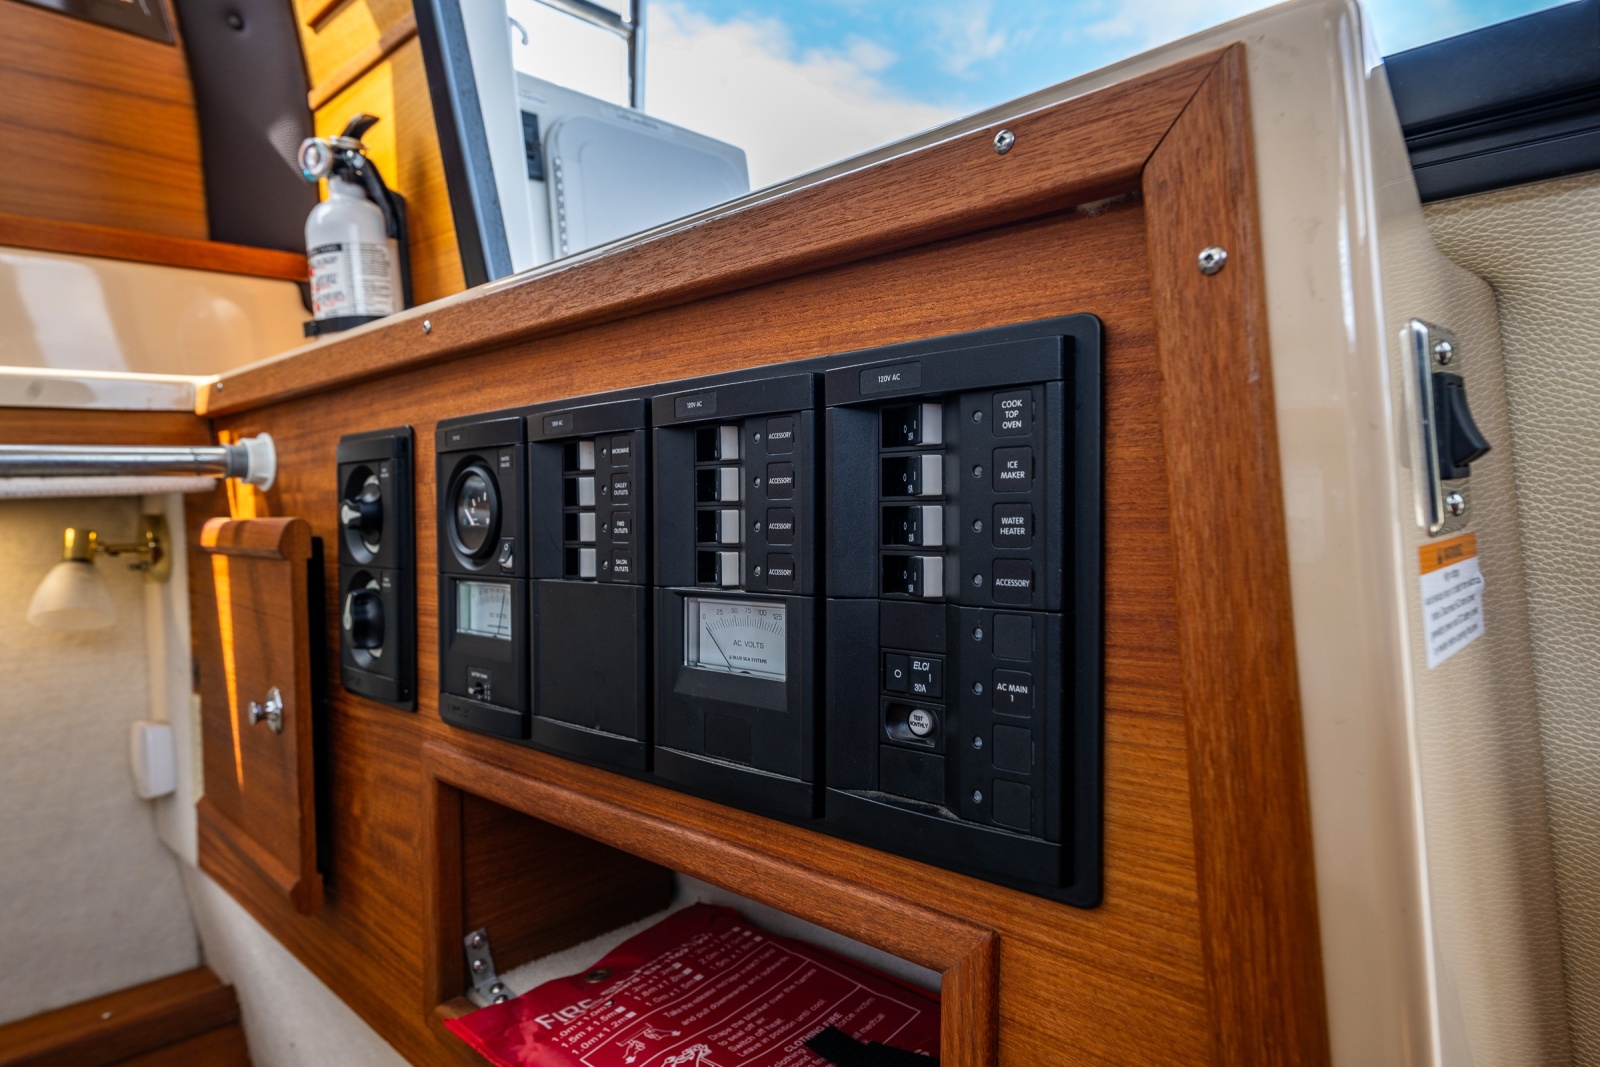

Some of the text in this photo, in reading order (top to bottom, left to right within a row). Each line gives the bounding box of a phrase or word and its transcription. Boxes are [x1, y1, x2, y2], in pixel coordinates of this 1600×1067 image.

[878, 373, 901, 383] 120V AC
[1002, 399, 1022, 408] COOK
[1005, 410, 1019, 419] TOP
[1002, 420, 1022, 429] OVEN
[1007, 461, 1018, 469] ICE
[1000, 470, 1025, 479] MAKER
[1001, 517, 1024, 525] WATER
[1000, 527, 1025, 536] HEATER
[996, 578, 1030, 588] ACCESSORY
[745, 641, 764, 649] VOLTS
[913, 661, 930, 671] ELCI
[914, 684, 926, 693] 30A
[997, 683, 1028, 694] AC MAIN
[680, 1016, 696, 1024] and
[695, 1008, 710, 1017] pull
[707, 1027, 732, 1039] Drape
[743, 1003, 769, 1019] blanket
[768, 993, 785, 1003] over
[782, 984, 796, 992] the
[727, 1030, 745, 1040] seal
[736, 1042, 762, 1056] Leave
[769, 1020, 796, 1038] position
[795, 1010, 811, 1020] until
[783, 1013, 840, 1051] CLOTHING FIRE
[728, 1035, 756, 1050] Switch
